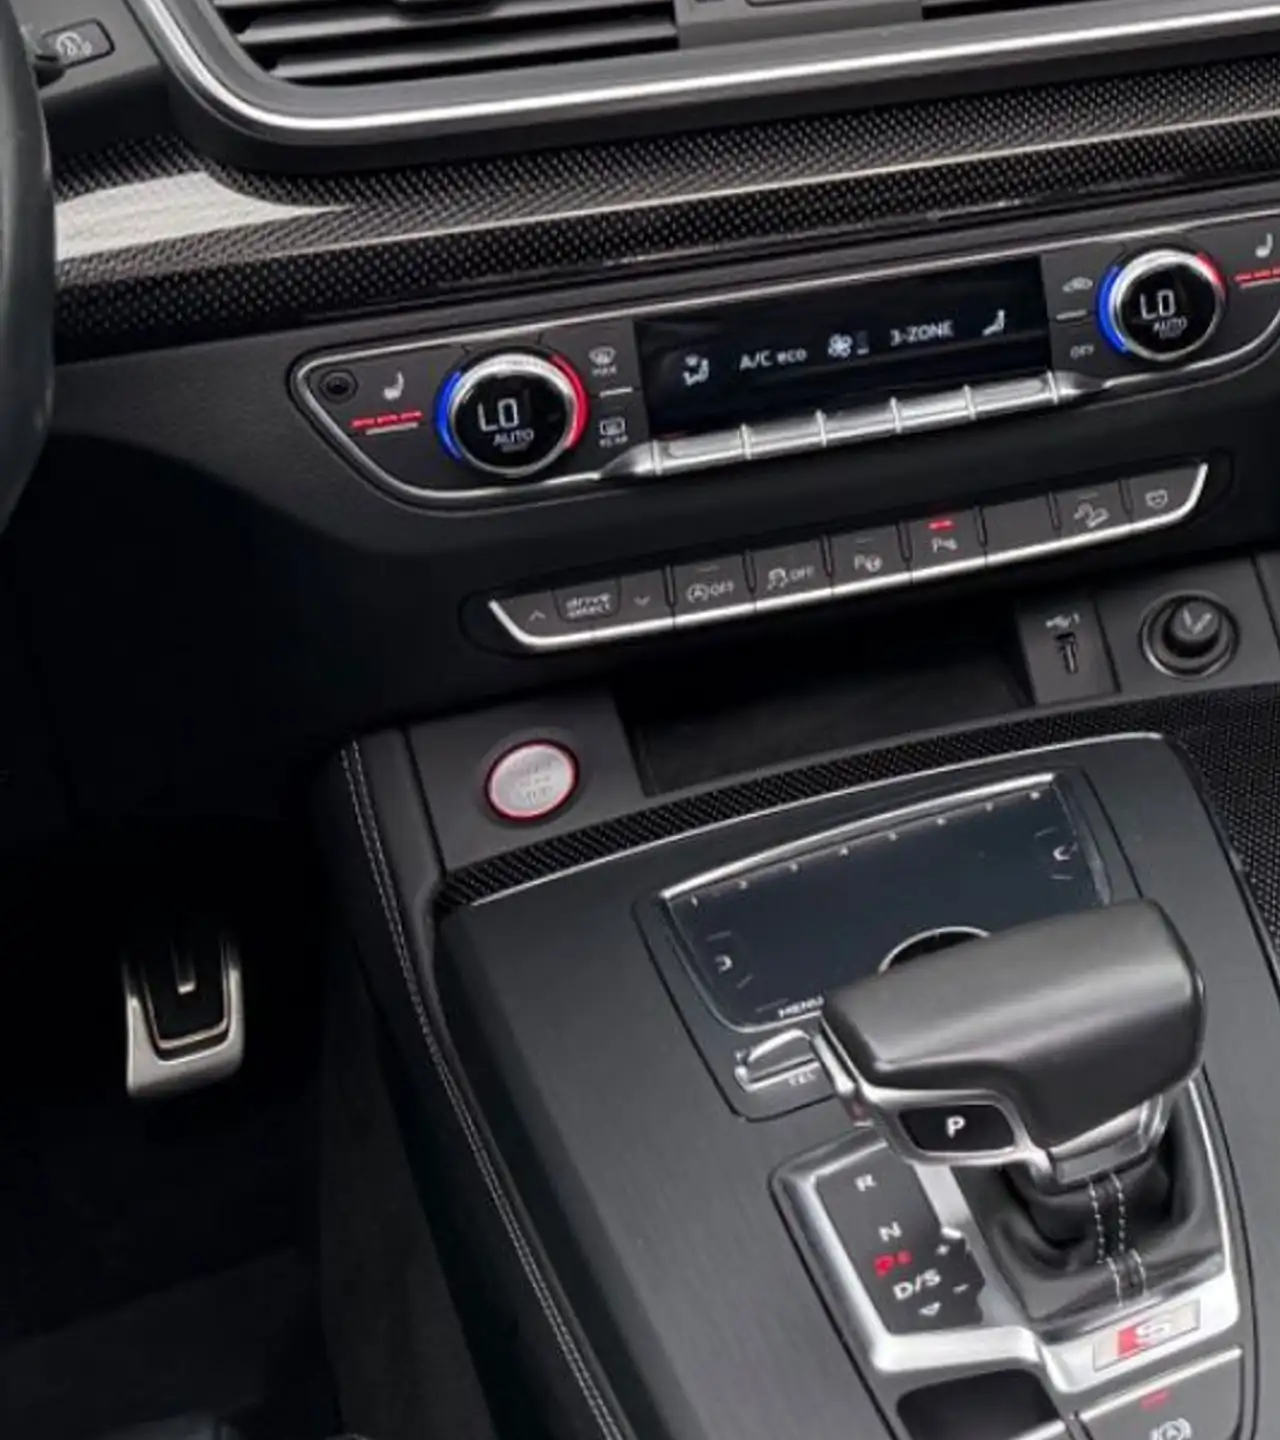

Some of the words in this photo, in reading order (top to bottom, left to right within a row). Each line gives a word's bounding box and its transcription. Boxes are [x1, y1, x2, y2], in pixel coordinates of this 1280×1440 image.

[890, 319, 954, 347] 3-ZONE
[739, 354, 773, 372] A/C
[777, 348, 808, 366] eco
[493, 427, 535, 447] AUTO
[946, 1115, 966, 1139] P
[855, 1173, 876, 1192] R
[879, 1220, 902, 1242] N
[892, 1268, 942, 1301] D/S
